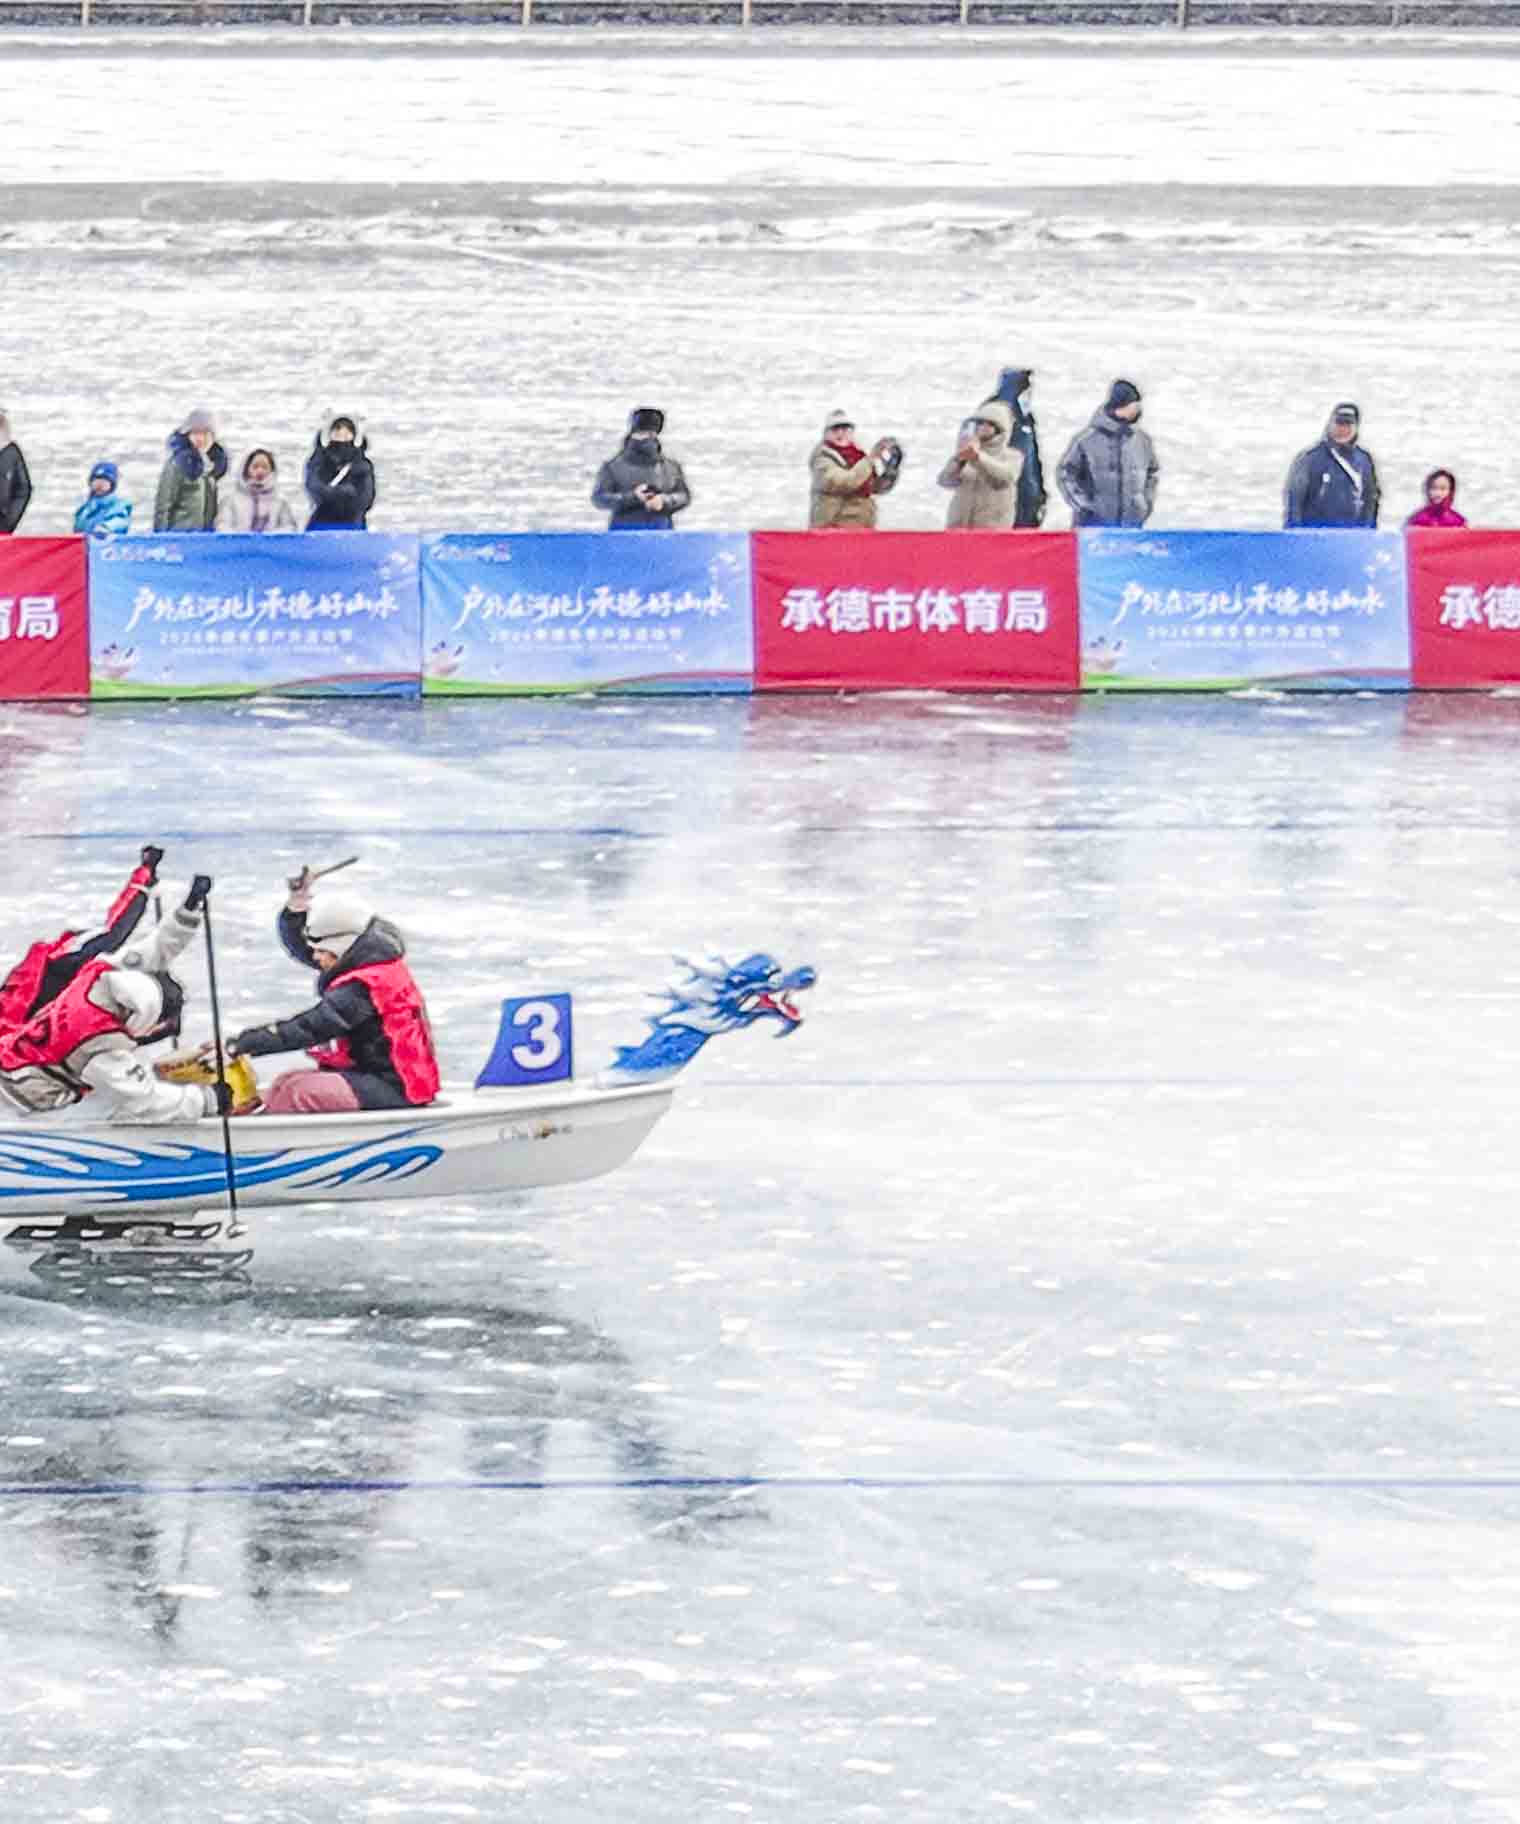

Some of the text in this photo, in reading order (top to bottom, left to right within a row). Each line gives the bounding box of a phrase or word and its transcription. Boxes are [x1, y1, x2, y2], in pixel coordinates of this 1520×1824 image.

[780, 588, 1047, 633] 承德市体育局
[511, 1001, 561, 1069] 3
